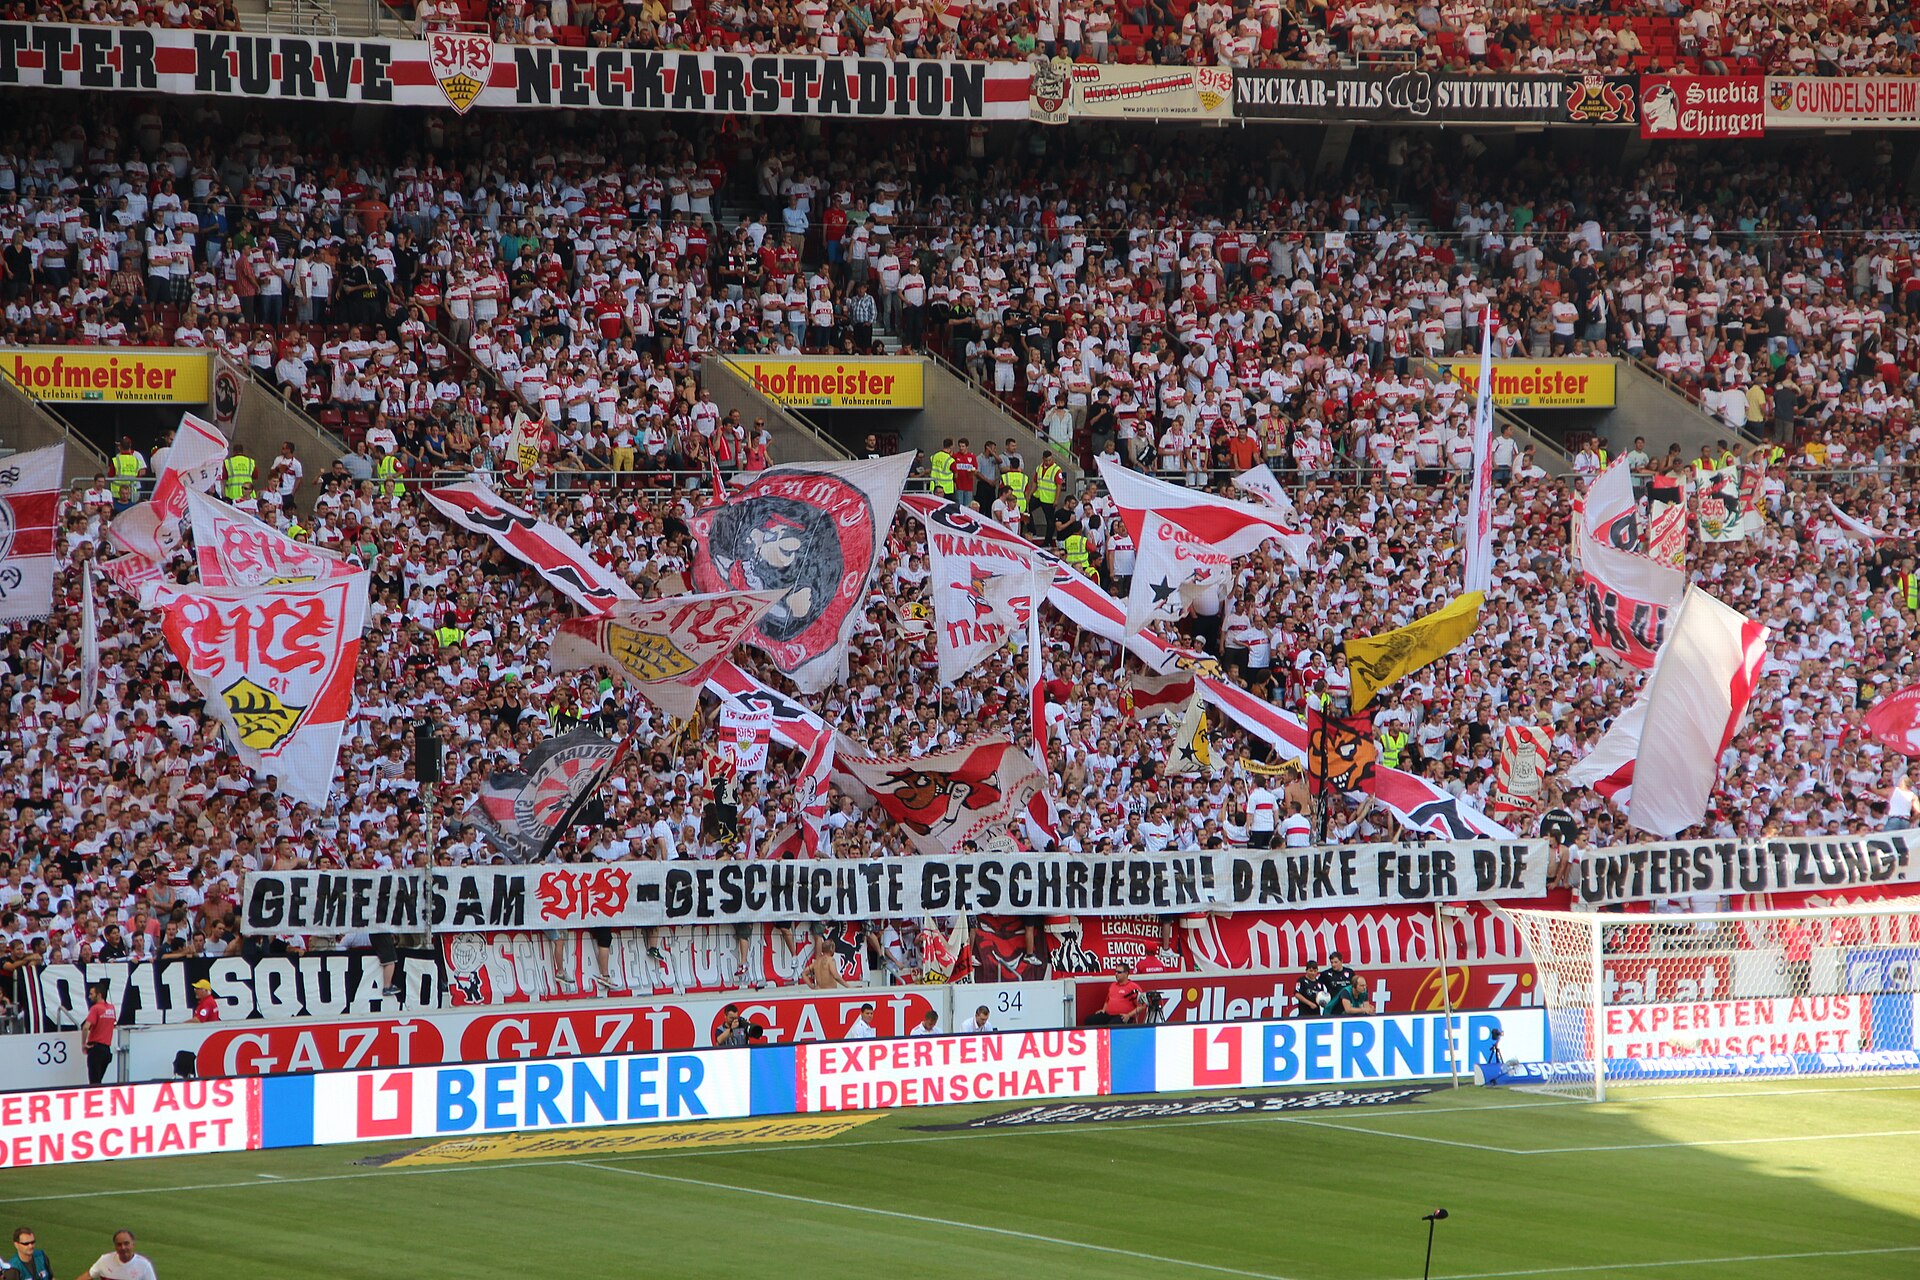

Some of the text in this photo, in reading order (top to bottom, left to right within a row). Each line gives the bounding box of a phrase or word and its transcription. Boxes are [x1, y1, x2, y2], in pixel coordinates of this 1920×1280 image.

[433, 36, 492, 69] VfB
[195, 34, 392, 102] KURVE
[514, 48, 985, 117] NECKARSTADION
[1071, 65, 1100, 83] PRO
[1199, 68, 1233, 91] VfB
[1084, 84, 1120, 104] ALTES
[1237, 77, 1562, 108] NECKAR-FILS STUTTGART
[1686, 81, 1759, 105] Suebia
[1796, 82, 1916, 112] GUNDELSHEIM
[1681, 110, 1763, 136] Ehingen
[15, 355, 176, 389] hofmeister
[754, 365, 895, 394] hofmeister
[42, 389, 78, 399] Erlebnis
[115, 390, 173, 400] Wohnzentrum
[841, 397, 892, 406] Wohnzentrum
[1539, 396, 1586, 405] Wohnzentrum
[739, 712, 769, 721] Jahre
[247, 874, 525, 928] GEMEINSAM
[921, 855, 1215, 911] GESCHRIEBEN!
[1233, 850, 1359, 904] DANKE
[1378, 841, 1458, 900] FÜR
[1474, 846, 1529, 893] DIE
[1581, 836, 1910, 903] UNTERSTÜTZUNG!
[40, 957, 439, 1026] 0711 SQUAD
[997, 991, 1023, 1013] 34
[1607, 996, 1851, 1035] EXPERTEN AUS
[37, 1040, 67, 1065] 33
[819, 1031, 1087, 1075] EXPERTEN AUS
[1263, 1015, 1503, 1083] BERNER
[153, 1079, 235, 1110] AUS
[437, 1057, 707, 1133] BERNER
[819, 1067, 1087, 1112] LEIDENSCHAFT
